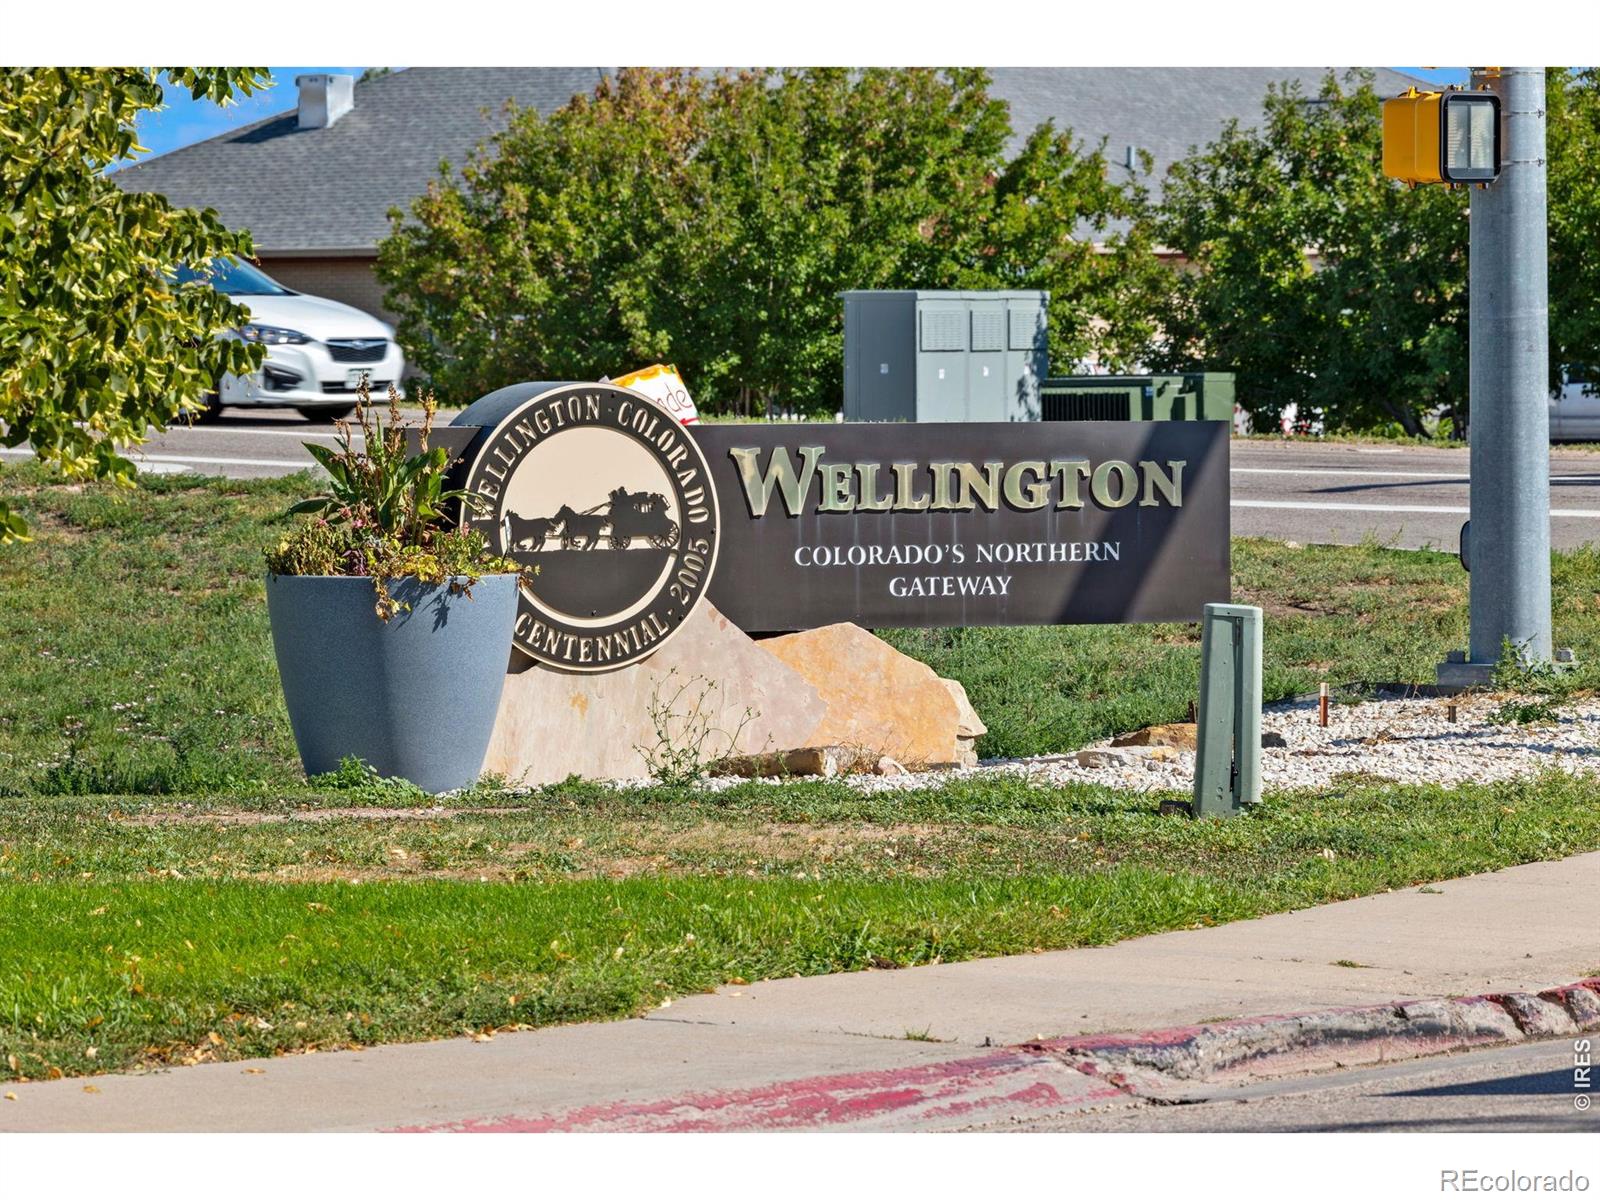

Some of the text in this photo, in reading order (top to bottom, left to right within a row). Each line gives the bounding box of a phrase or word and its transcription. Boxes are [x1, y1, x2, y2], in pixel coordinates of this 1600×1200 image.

[471, 393, 710, 524] WELLINGTON COLORADO
[794, 541, 1122, 567] COLORADO'S NORTHERN
[888, 575, 1013, 598] GATEWAY
[514, 537, 710, 663] CENTENNIAL 2005
